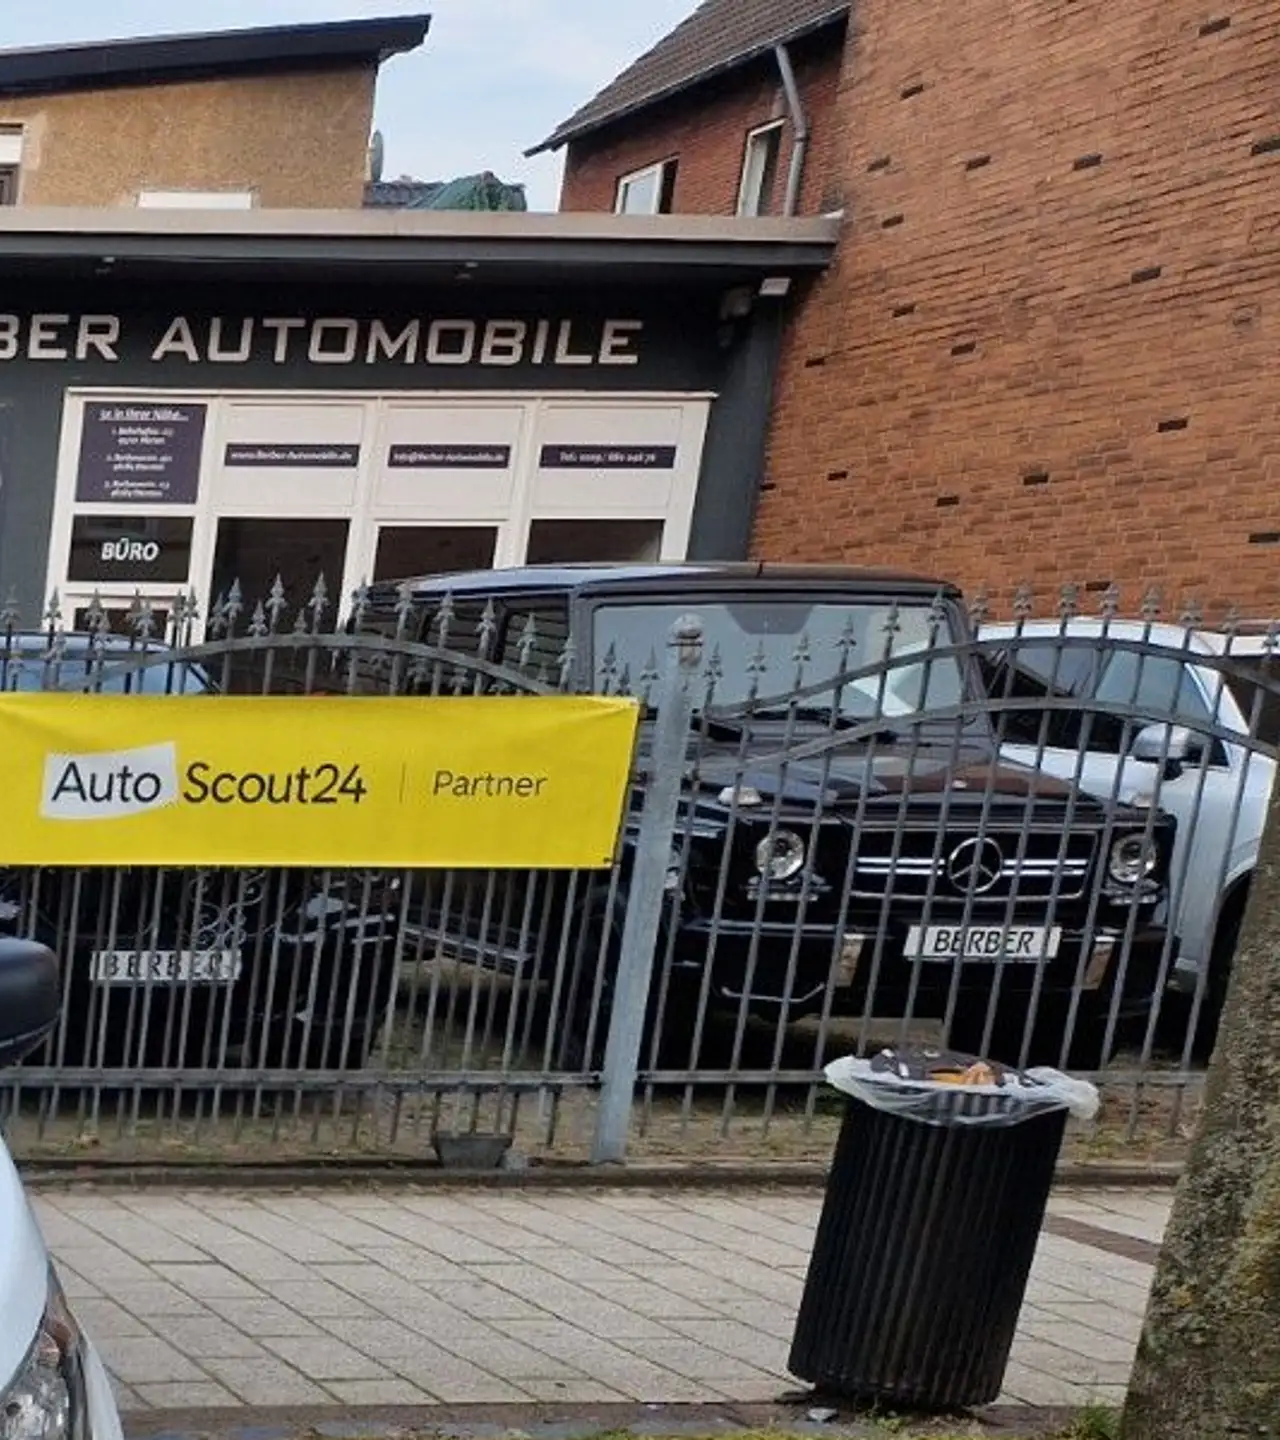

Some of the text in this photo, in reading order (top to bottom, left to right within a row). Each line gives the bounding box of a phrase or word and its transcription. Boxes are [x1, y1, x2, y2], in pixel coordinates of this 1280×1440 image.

[151, 316, 643, 365] AUTOMOBILE
[101, 537, 159, 560] BÜRO
[52, 760, 547, 804] Auto Scout24 Partner
[934, 928, 1035, 954] BERBER
